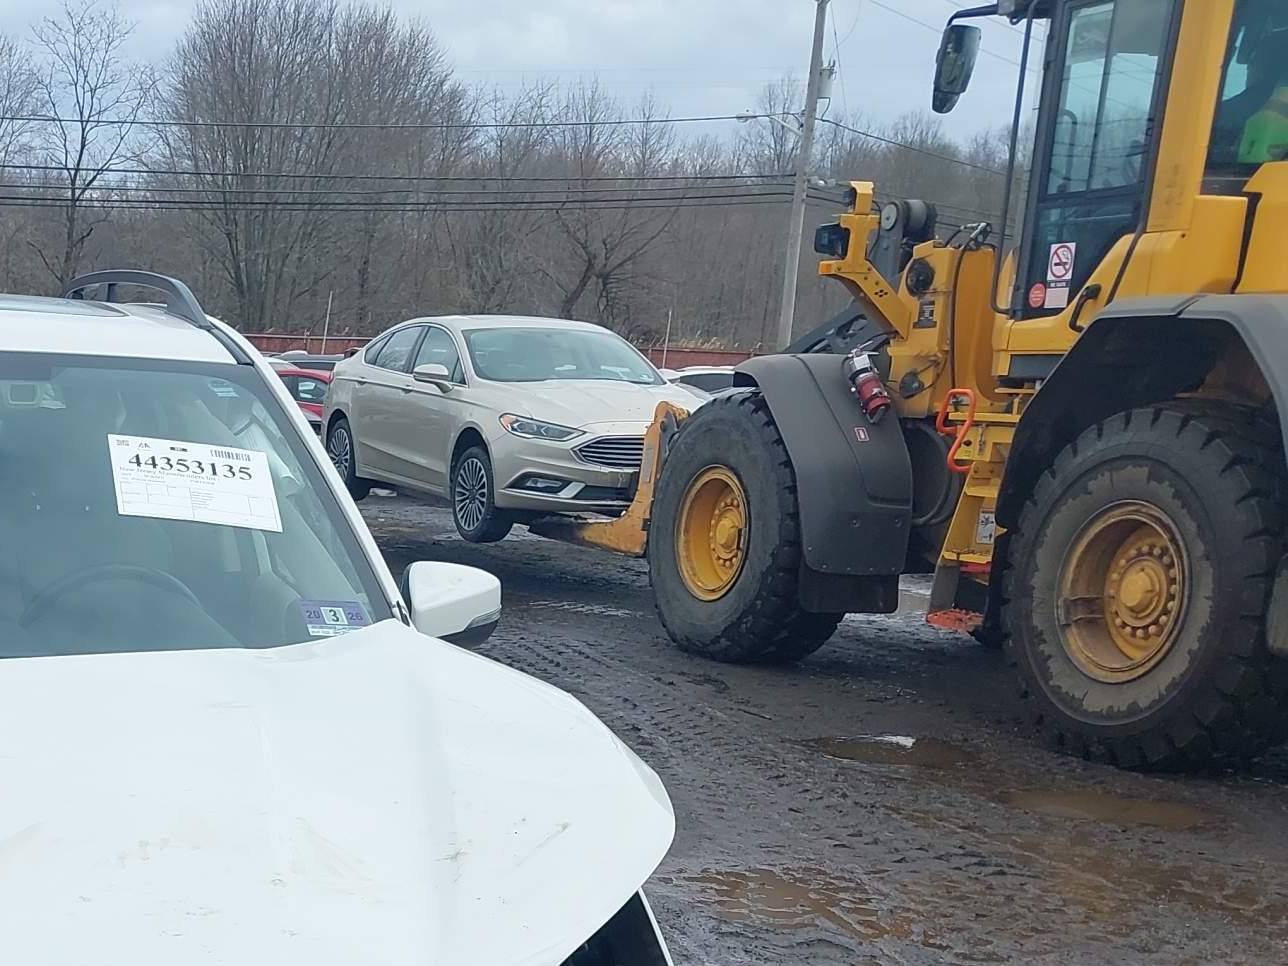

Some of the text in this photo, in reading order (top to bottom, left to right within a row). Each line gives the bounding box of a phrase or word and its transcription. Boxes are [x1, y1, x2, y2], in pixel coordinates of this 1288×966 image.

[128, 453, 253, 482] 44353135
[305, 609, 364, 622] 20 3 26
